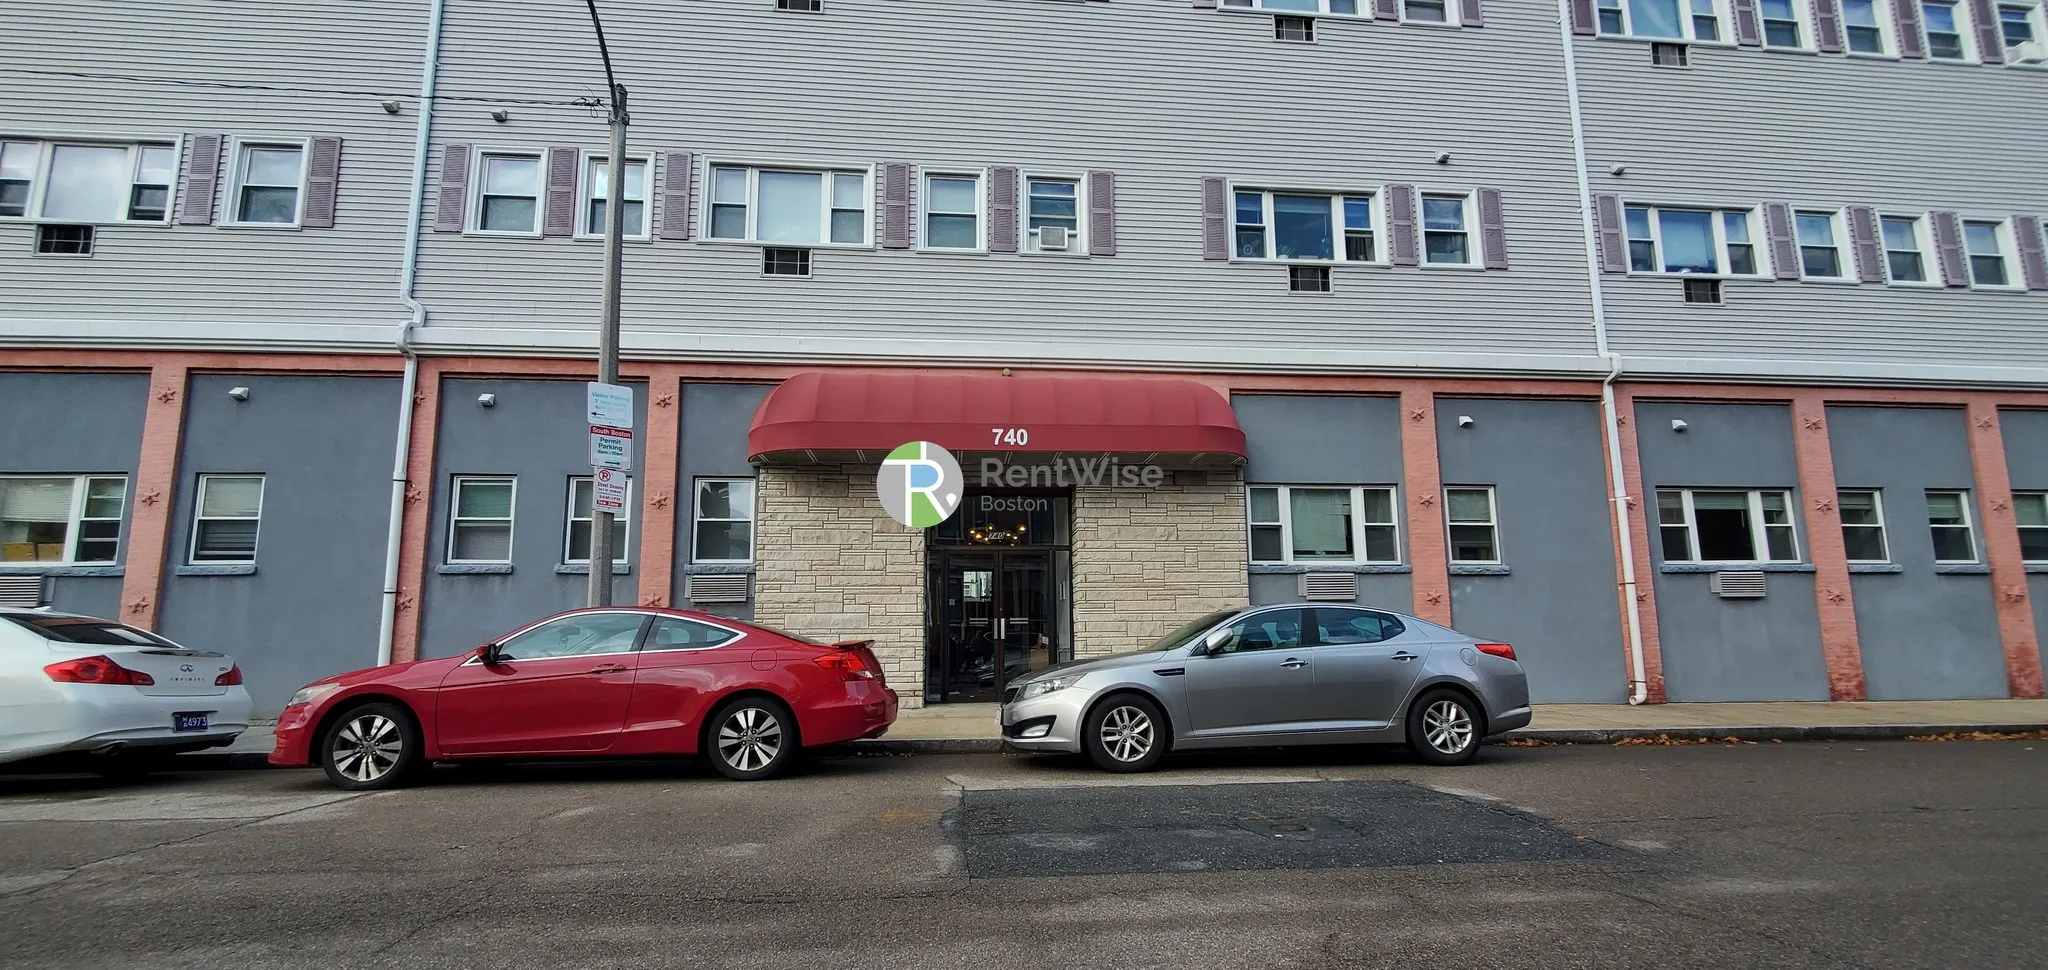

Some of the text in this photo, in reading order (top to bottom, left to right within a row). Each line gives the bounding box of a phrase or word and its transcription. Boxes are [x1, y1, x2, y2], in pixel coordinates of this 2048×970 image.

[592, 426, 631, 438] South Boston
[991, 428, 1028, 446] 740
[600, 436, 621, 445] Permit
[598, 442, 623, 452] Parking
[187, 716, 207, 727] 4973
